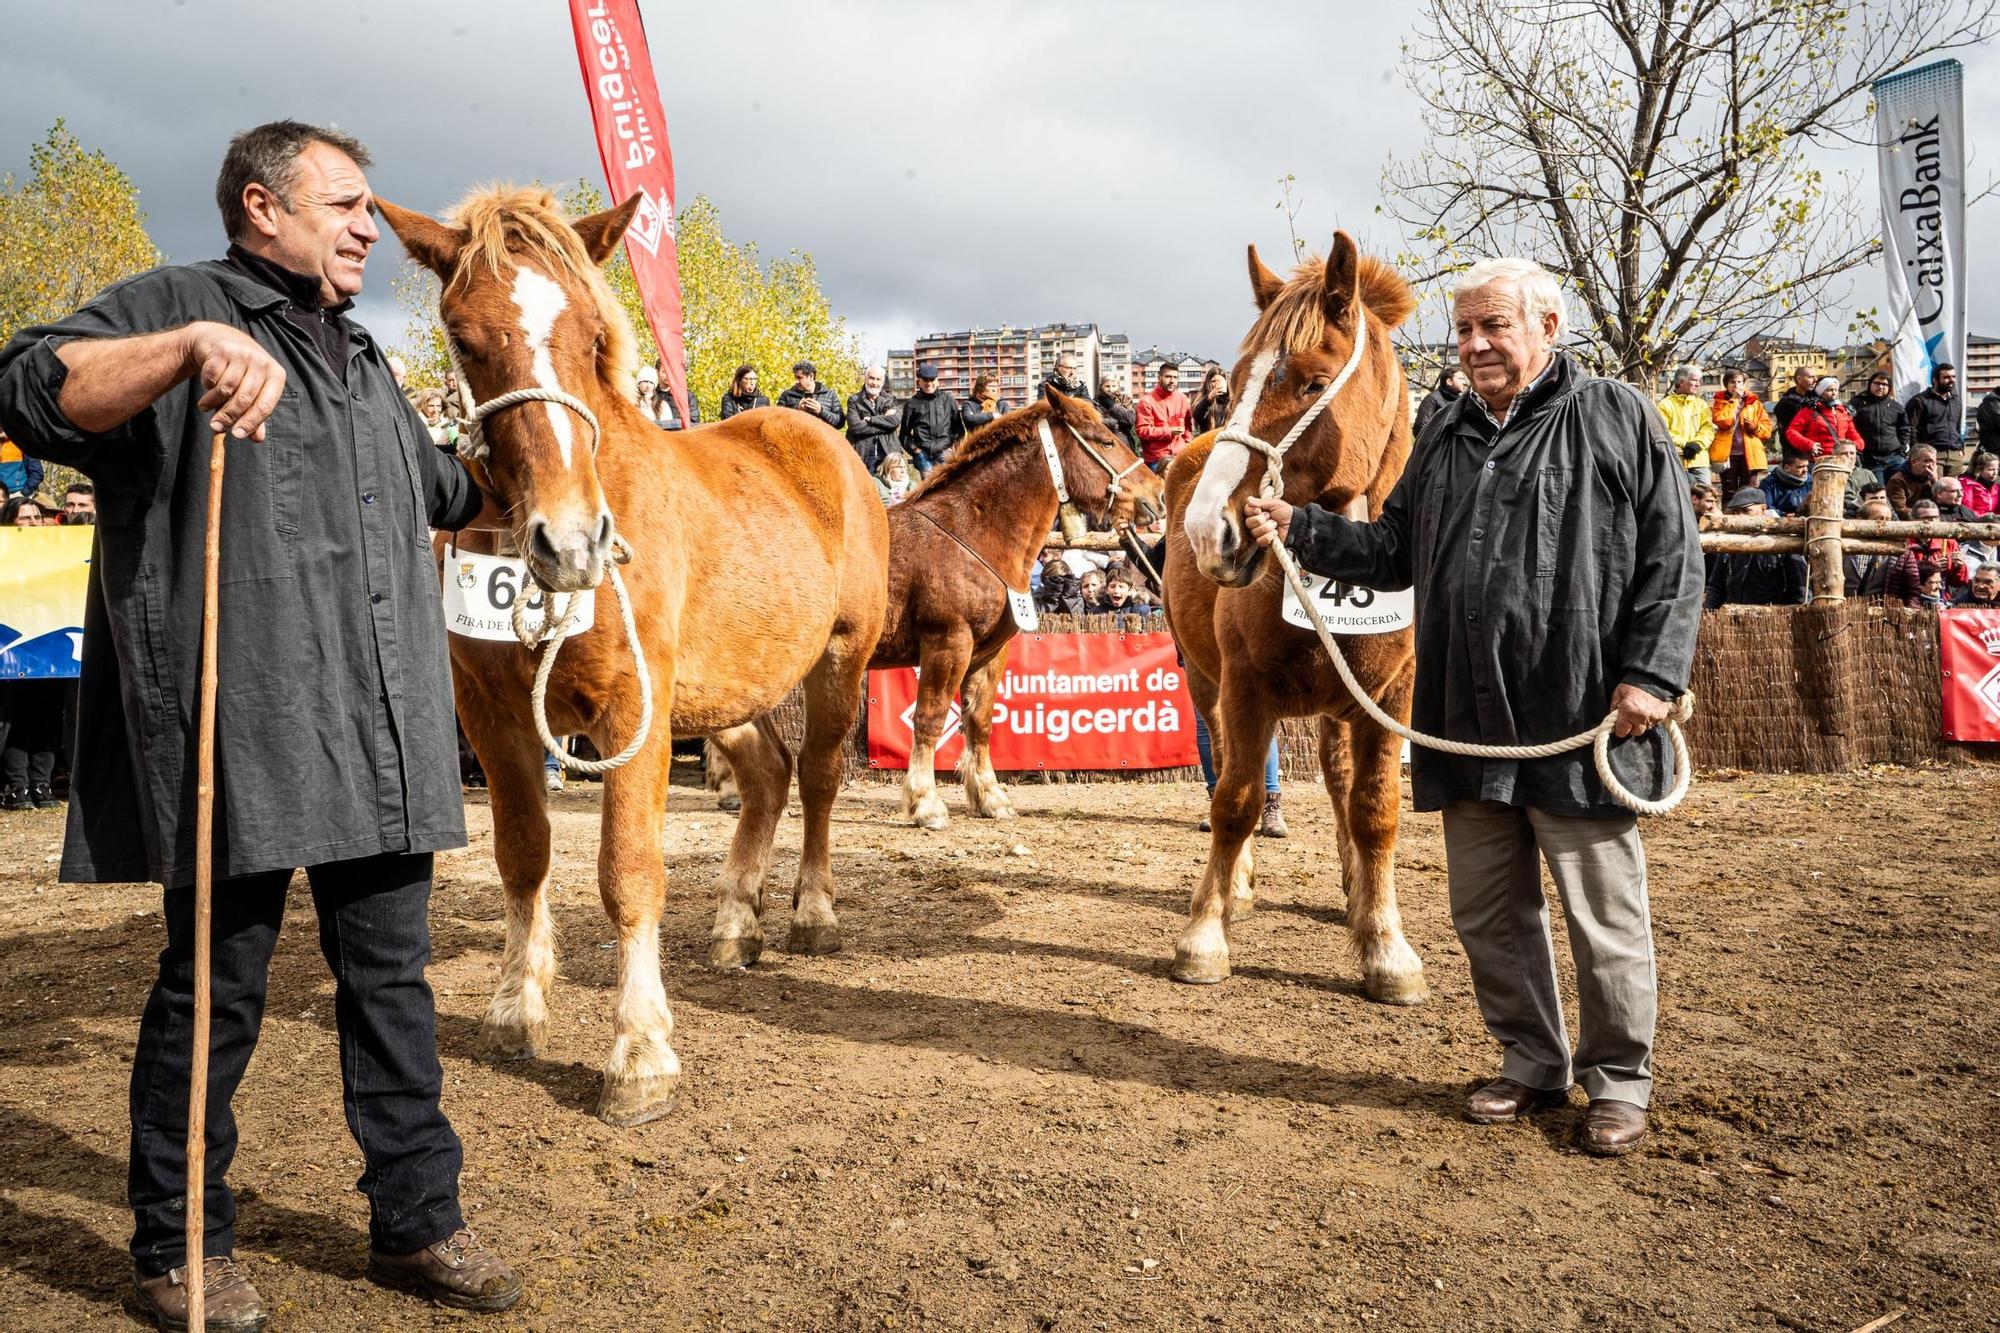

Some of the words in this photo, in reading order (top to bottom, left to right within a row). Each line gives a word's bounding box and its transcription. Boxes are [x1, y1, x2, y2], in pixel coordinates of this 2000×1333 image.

[1900, 113, 1945, 327] CaixaBank
[1318, 578, 1375, 608] 45
[456, 613, 483, 629] FIRA
[487, 619, 504, 631] DE
[1320, 614, 1335, 625] DE
[1337, 611, 1402, 626] PUIGCERDÀ
[1146, 667, 1179, 691] de
[991, 699, 1179, 743] Puigcerdà
